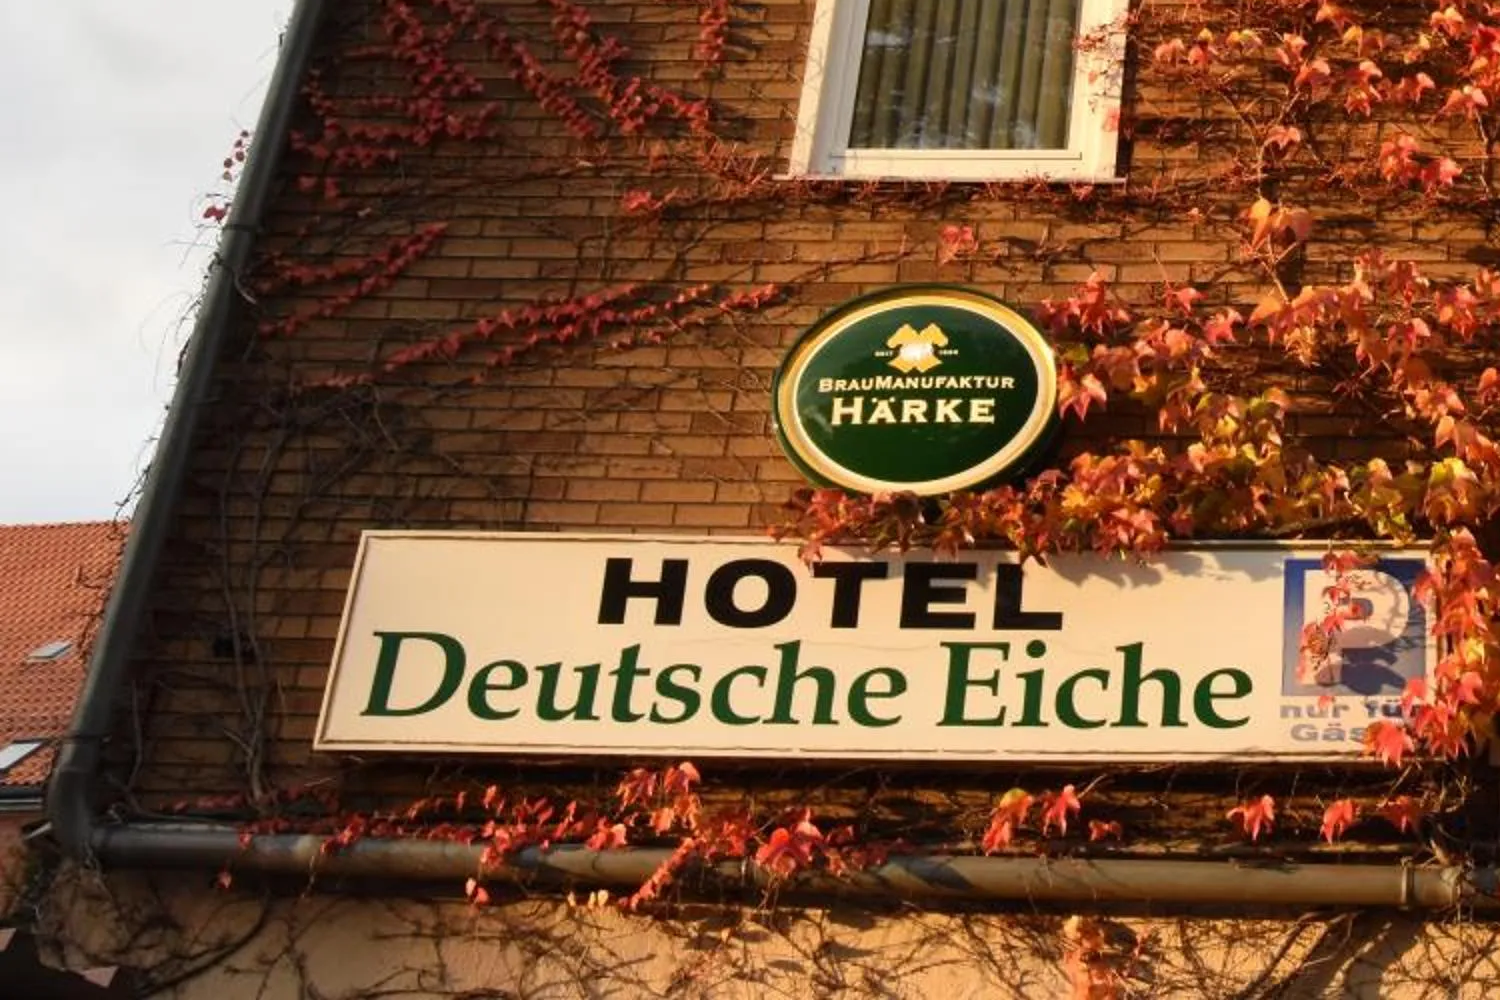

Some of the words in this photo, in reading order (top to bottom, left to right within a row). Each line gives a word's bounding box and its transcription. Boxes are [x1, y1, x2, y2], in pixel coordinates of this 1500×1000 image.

[831, 396, 996, 426] HÄRKE
[598, 557, 1062, 630] HOTEL
[360, 631, 907, 726] Deutsche
[937, 640, 1253, 729] Eiche
[1280, 703, 1349, 719] nur
[1291, 723, 1367, 742] Gäs
